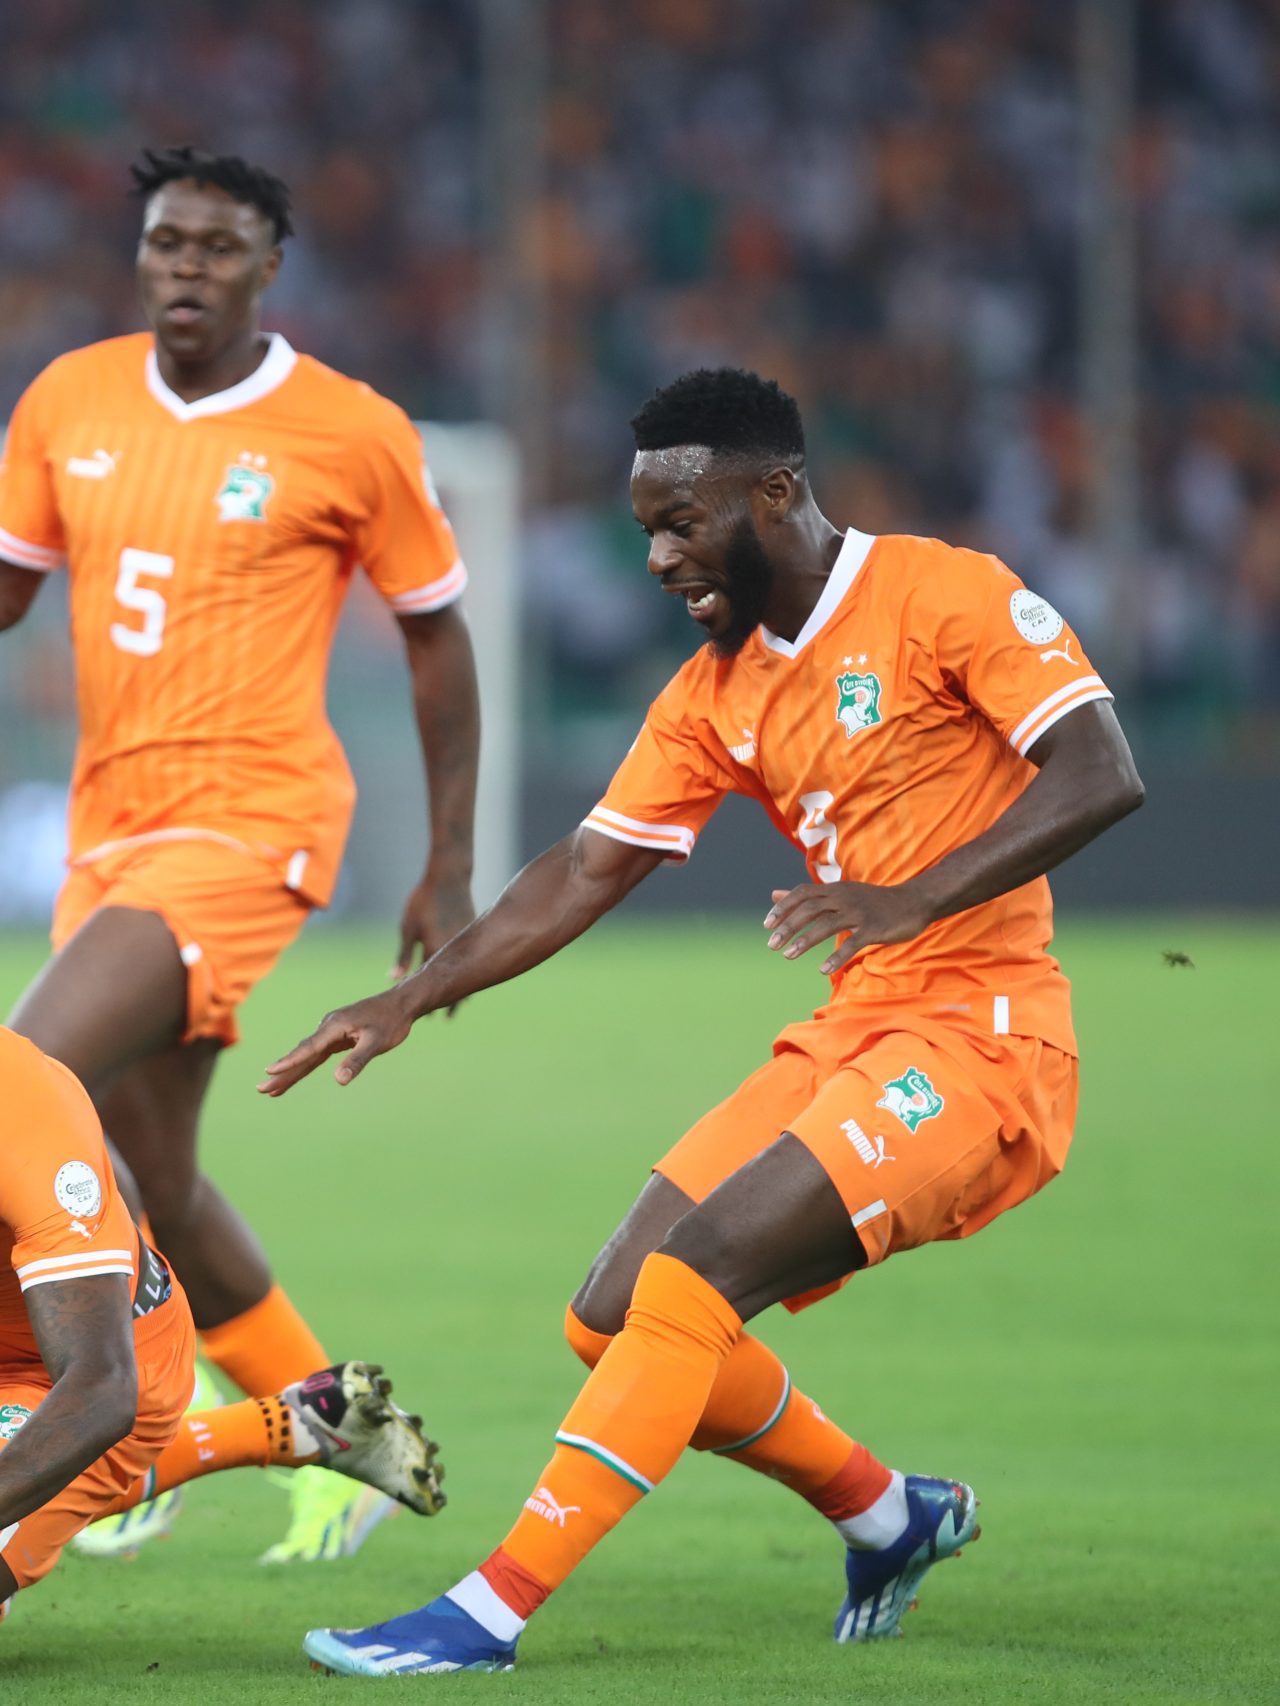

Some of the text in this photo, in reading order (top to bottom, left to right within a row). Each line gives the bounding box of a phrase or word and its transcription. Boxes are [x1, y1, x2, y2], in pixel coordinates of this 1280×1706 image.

[109, 547, 175, 658] 5
[798, 790, 842, 883] 9
[840, 1118, 878, 1165] PUMA
